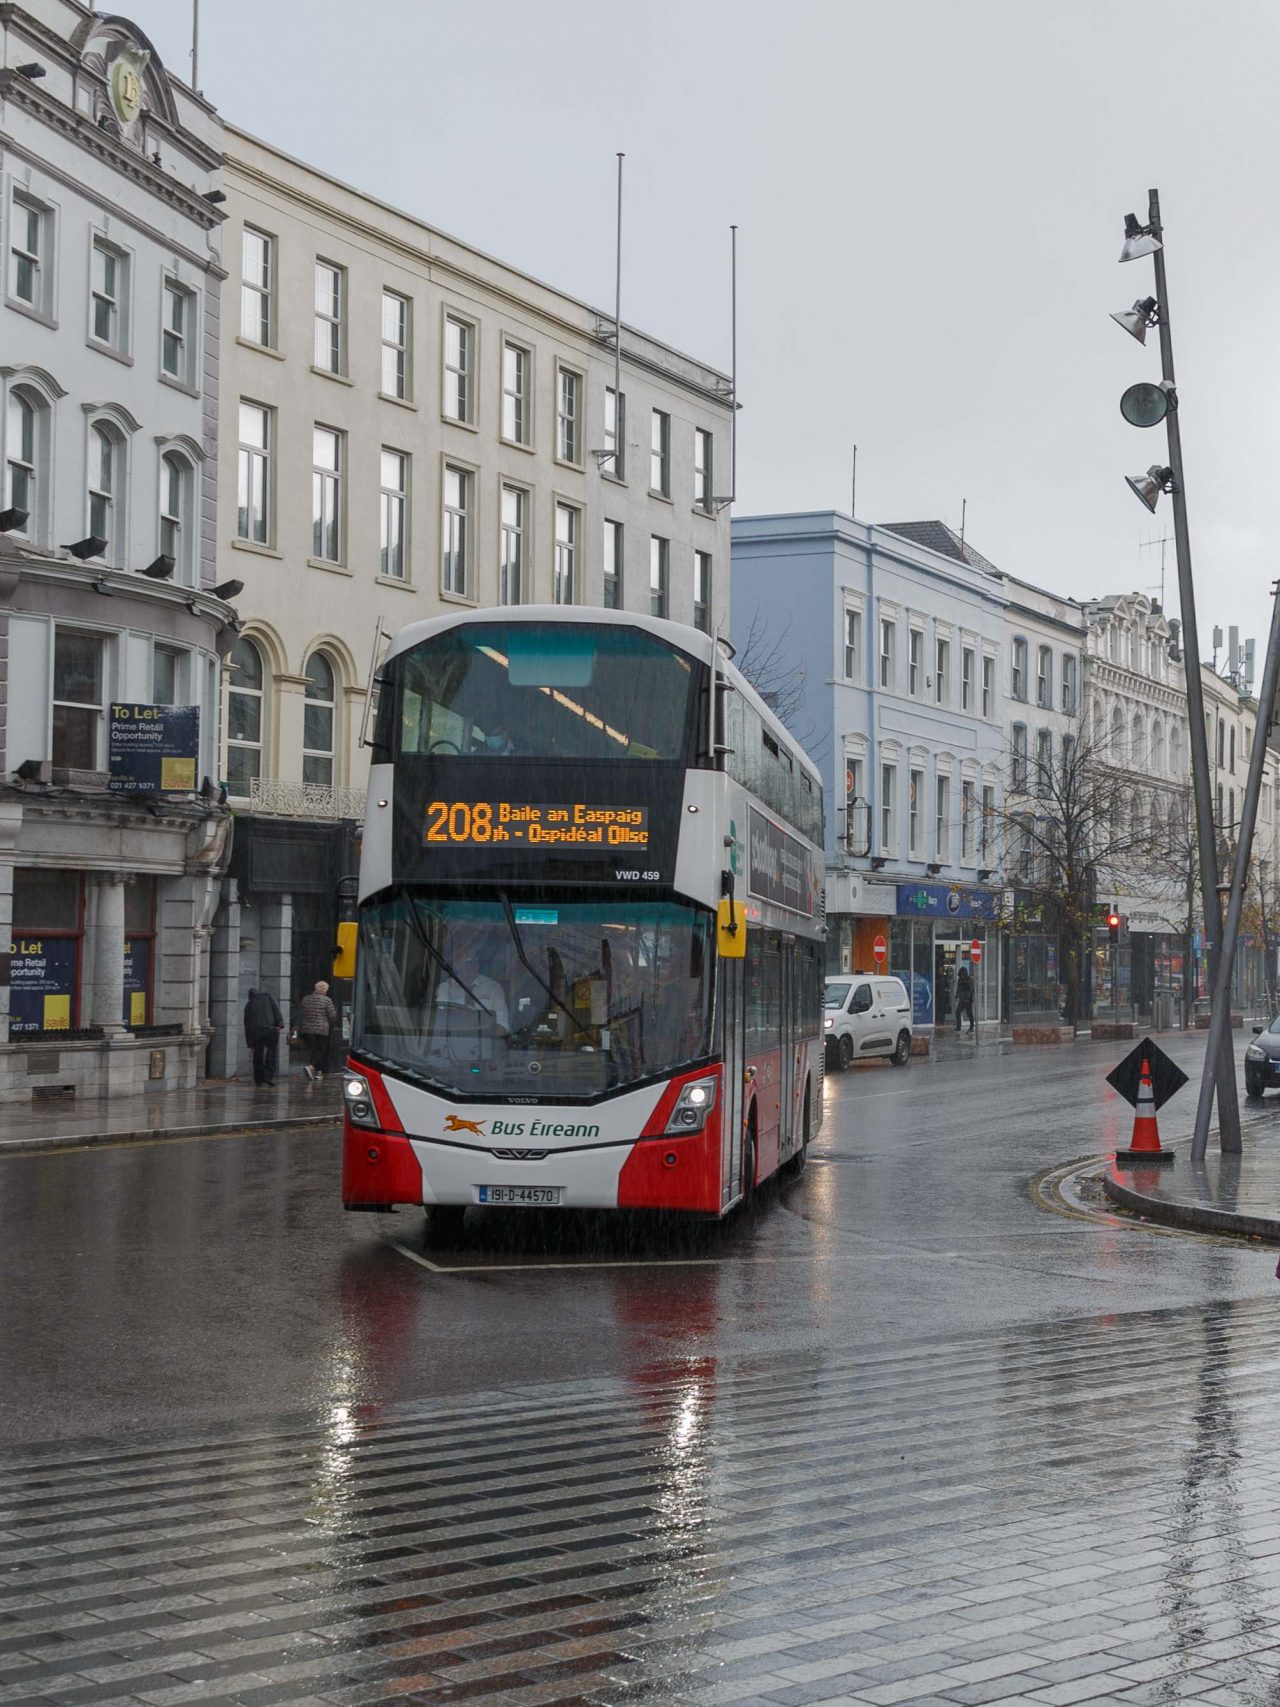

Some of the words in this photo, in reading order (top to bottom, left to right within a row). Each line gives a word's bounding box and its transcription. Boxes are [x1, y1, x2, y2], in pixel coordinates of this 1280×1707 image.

[112, 705, 130, 719] To
[134, 706, 159, 719] Let
[112, 722, 137, 731] Prime
[139, 722, 164, 731] Retail
[112, 731, 163, 742] Opportunity
[499, 803, 541, 822] Baile
[547, 810, 569, 821] an
[574, 804, 642, 824] Easpaig
[427, 802, 493, 842] 208
[528, 823, 603, 843] Ospidéal
[616, 871, 640, 880] VWD
[642, 871, 660, 881] 459
[8, 943, 17, 954] o
[21, 941, 43, 954] Let
[25, 958, 47, 967] Retail
[10, 967, 46, 977] portunity
[491, 1120, 525, 1136] Bus
[491, 1188, 554, 1202] 191-D-44570
